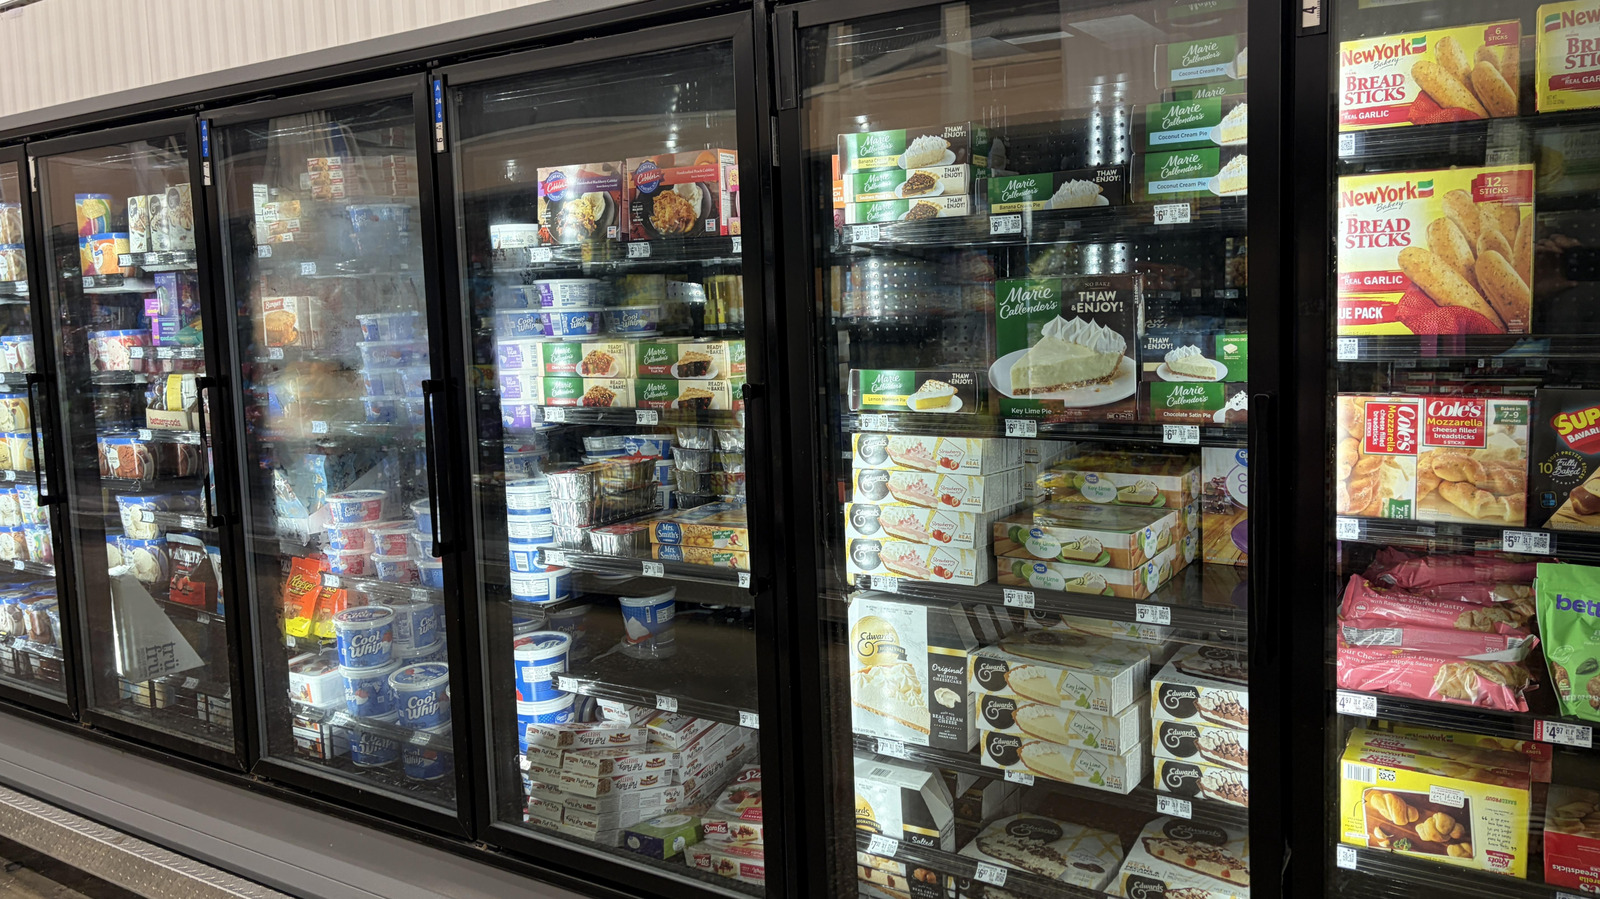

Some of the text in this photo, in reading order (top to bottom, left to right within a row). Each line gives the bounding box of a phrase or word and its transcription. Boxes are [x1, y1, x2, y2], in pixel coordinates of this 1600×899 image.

[1495, 27, 1502, 35] 6
[1346, 74, 1405, 92] BREAD
[1344, 87, 1406, 106] STICKS
[1163, 104, 1202, 120] Marie
[1358, 110, 1389, 120] GARLIC
[1162, 114, 1204, 130] Callender's
[1161, 154, 1200, 170] Marie
[1161, 163, 1203, 179] Callender's
[1002, 178, 1036, 193] Marie
[1486, 177, 1501, 187] 12
[1479, 186, 1509, 195] STICKS
[1346, 218, 1410, 235] BREAD
[1345, 232, 1411, 249] STICKS
[1364, 276, 1403, 285] GARLIC
[1000, 286, 1053, 305] Marie
[1078, 291, 1116, 301] THAW
[1000, 300, 1057, 319] Callender's
[1355, 307, 1383, 319] PACK
[517, 322, 535, 331] Whip
[571, 316, 585, 324] Cool
[648, 348, 667, 356] Marie
[646, 383, 667, 393] Marie
[1167, 386, 1205, 398] Marie
[1167, 396, 1208, 407] Callender's
[1428, 400, 1481, 417] Cole's
[1387, 405, 1396, 452] Mozzarella
[1397, 406, 1416, 453] Cole's
[1427, 417, 1483, 427] Mozzarella
[1538, 462, 1553, 474] 10
[1552, 466, 1581, 476] Baked
[1556, 458, 1578, 469] Fully
[658, 529, 678, 539] Smith's
[661, 552, 680, 561] Smith's
[664, 545, 676, 554] Mrs.
[289, 574, 316, 591] Reese's
[1439, 603, 1464, 611] Pastry
[352, 632, 380, 648] Cool
[349, 642, 383, 659] Whip
[932, 663, 963, 675] Original
[978, 663, 1006, 682] Edwards
[408, 692, 436, 709] Cool
[1164, 690, 1197, 709] Edwards
[406, 702, 440, 720] Whip
[985, 701, 1014, 720] Edwards
[1165, 728, 1197, 748] Edwards
[990, 737, 1018, 756] Edwards
[1166, 768, 1198, 787] Edwards
[704, 824, 727, 833] Sara Lee
[1010, 822, 1058, 837] Edwards
[1170, 825, 1222, 840] Edwards
[912, 836, 934, 847] Salted
[1488, 856, 1510, 866] Knots
[1552, 864, 1598, 878] breadsticks
[1131, 881, 1163, 899] Edwards
